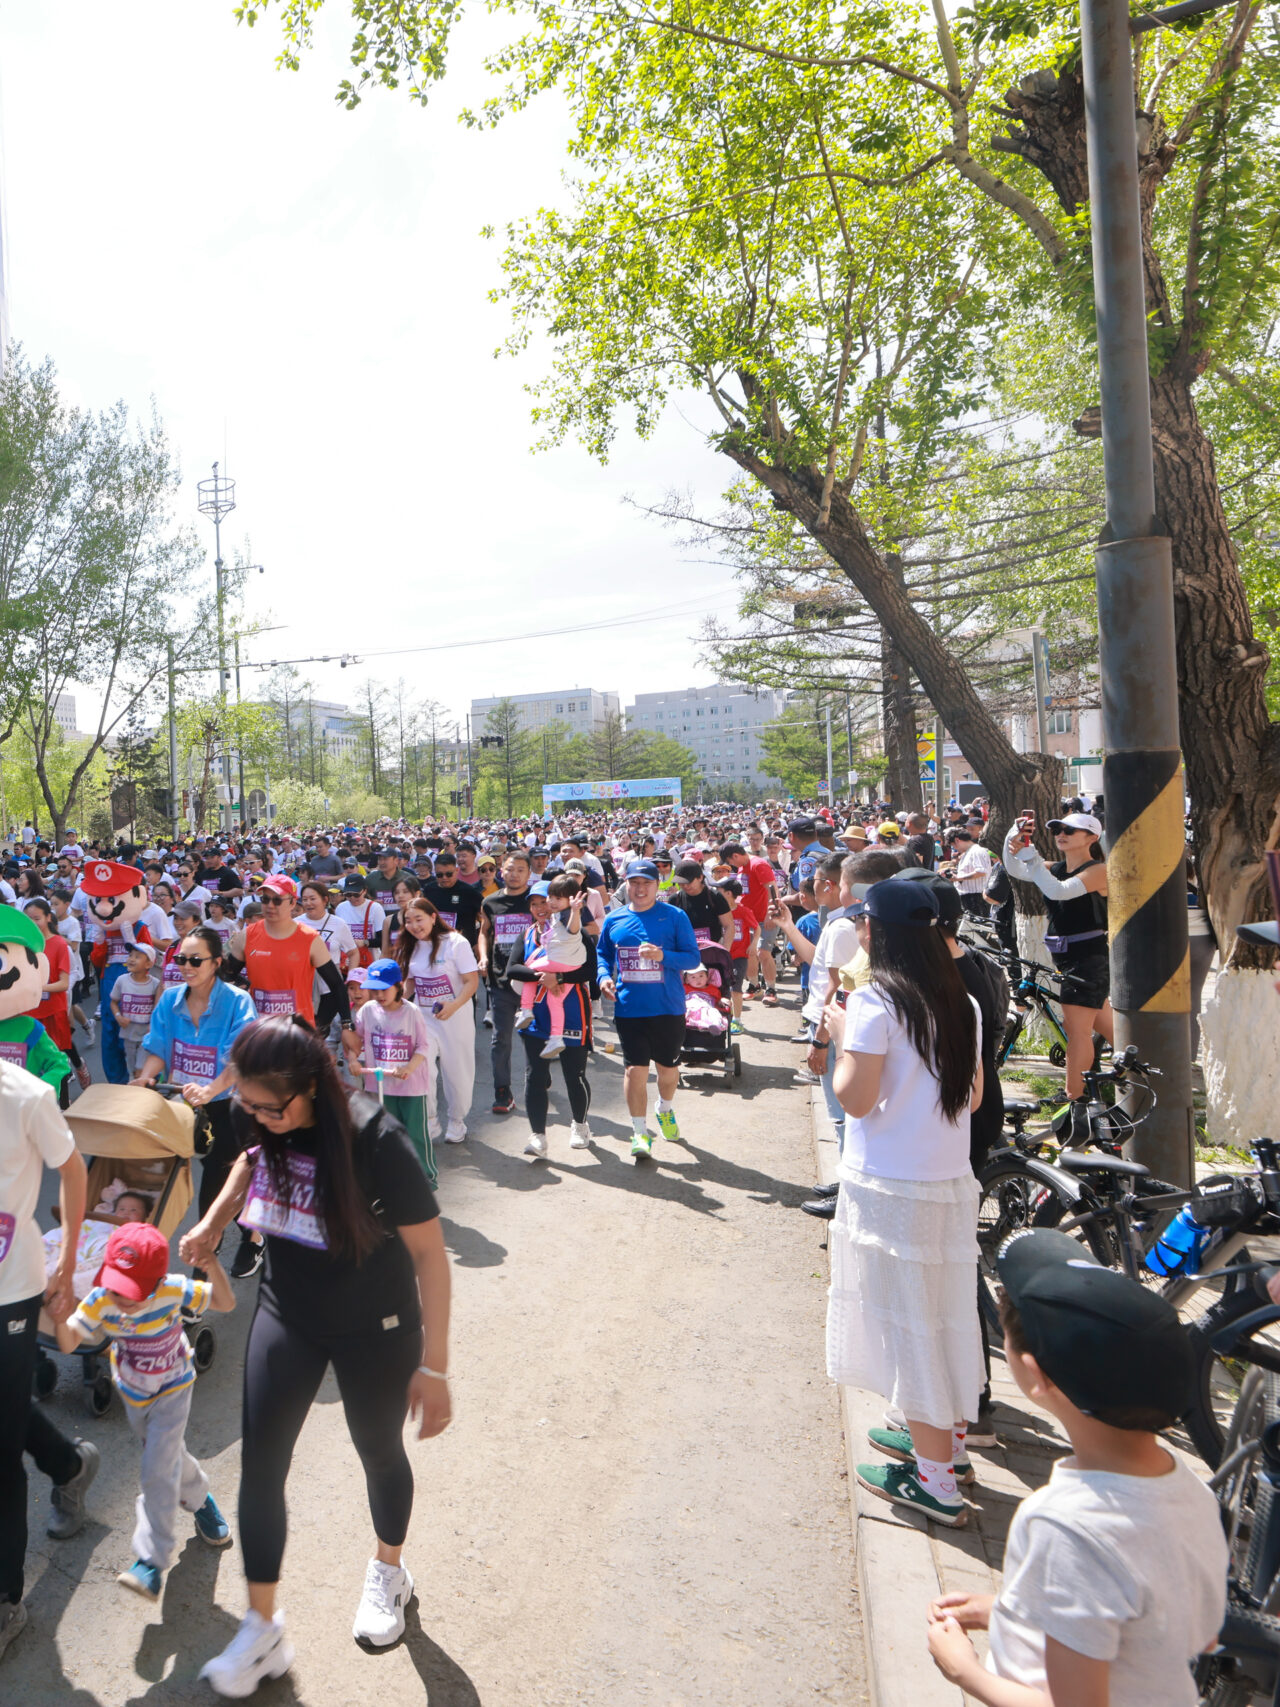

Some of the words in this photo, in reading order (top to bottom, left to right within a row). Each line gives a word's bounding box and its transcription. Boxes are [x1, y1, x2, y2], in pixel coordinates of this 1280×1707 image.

[96, 868, 110, 878] M
[264, 1002, 294, 1015] 31205
[381, 1047, 410, 1061] 31201
[182, 1057, 215, 1077] 31206
